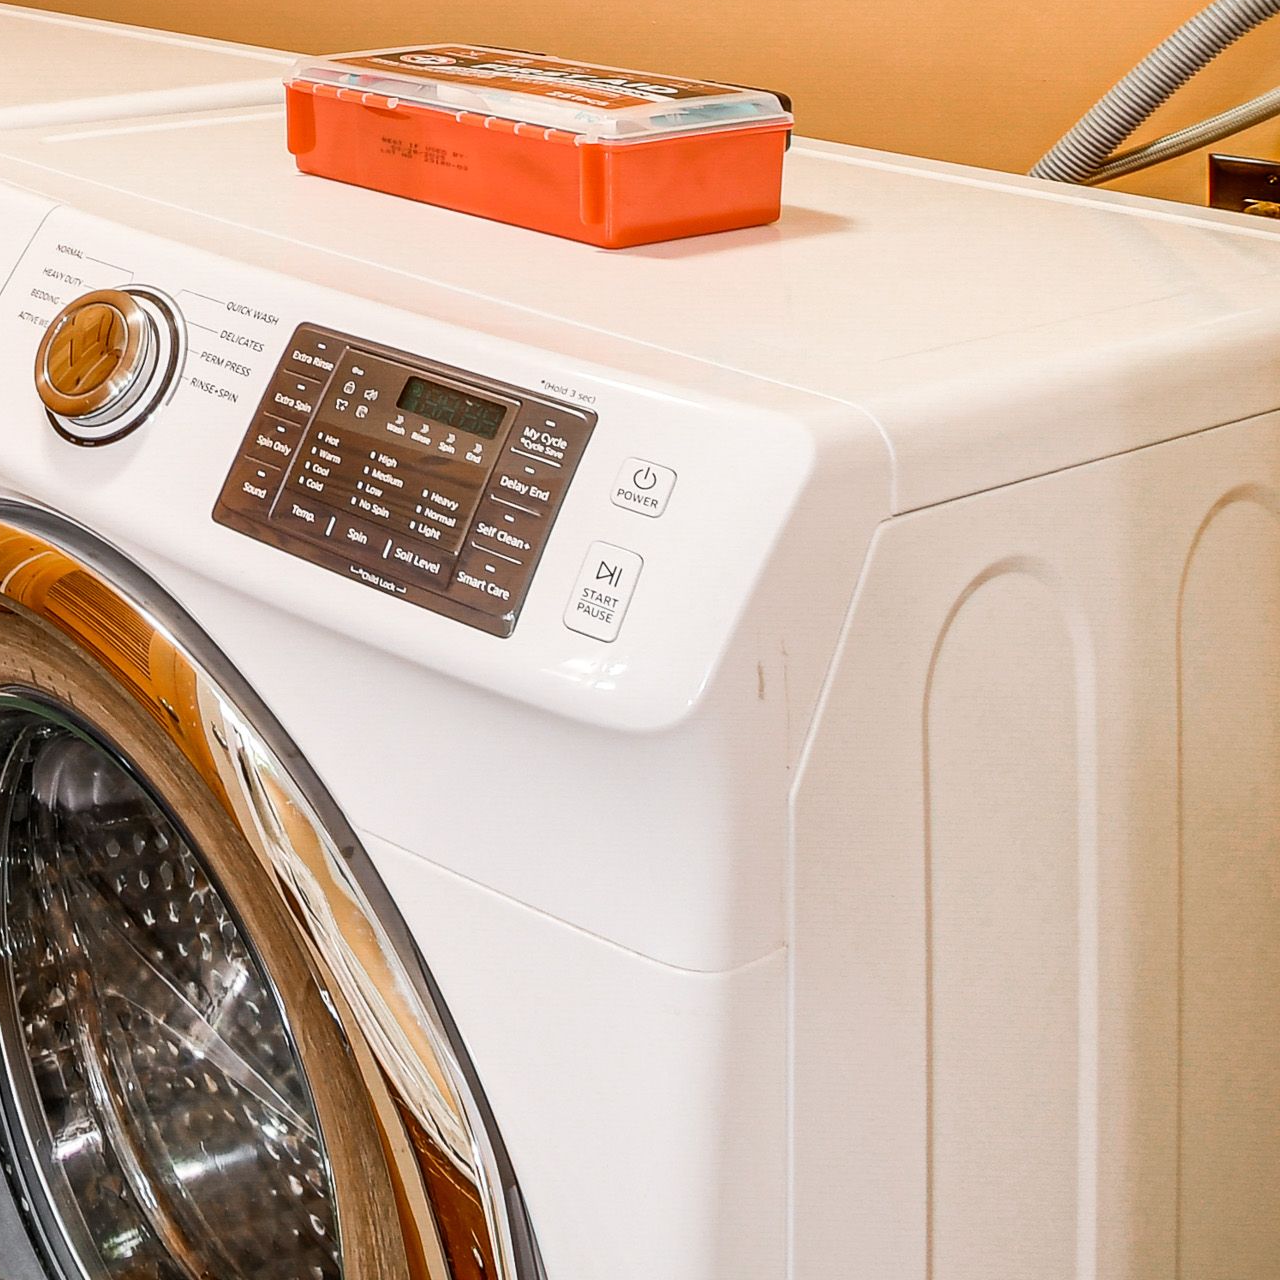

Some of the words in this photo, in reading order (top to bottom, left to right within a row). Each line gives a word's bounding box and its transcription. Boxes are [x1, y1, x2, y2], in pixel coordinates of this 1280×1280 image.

[470, 63, 596, 80] FIRST
[586, 78, 679, 94] AID
[55, 244, 83, 259] NORMAL
[43, 267, 64, 281] HEAVY
[64, 274, 83, 287] DUTY
[30, 288, 60, 305] BEDDING
[226, 301, 253, 317] QUICK
[254, 309, 279, 326] WASH
[220, 330, 265, 353] DELICATES
[200, 351, 224, 366] PERM
[224, 360, 251, 377] PRESS
[292, 350, 313, 364] Extra
[313, 356, 334, 372] Rinse
[274, 392, 295, 407] Extra
[294, 399, 312, 413] Spin
[569, 389, 576, 398] 3
[578, 393, 596, 404] sec)
[256, 434, 274, 448] Spin
[273, 441, 292, 456] Only
[324, 435, 340, 447] Hot
[386, 422, 406, 436] Wash
[438, 441, 456, 455] Spin
[465, 451, 482, 464] End
[523, 426, 540, 440] My
[541, 433, 568, 450] Cycle
[319, 449, 342, 464] Warm
[377, 453, 398, 468] High
[312, 463, 330, 477] Cool
[371, 468, 404, 488] Medium
[242, 481, 267, 499] Sound
[306, 478, 324, 492] Cold
[365, 483, 384, 498] Low
[499, 475, 529, 495] Delay
[529, 485, 551, 501] End
[430, 491, 459, 511] Heavy
[616, 487, 659, 509] POWER
[358, 498, 372, 511] No
[371, 504, 390, 519] Spin
[423, 507, 457, 528] Normal
[346, 528, 368, 545] Spin
[417, 522, 442, 541] Light
[476, 522, 498, 538] Self
[394, 547, 413, 563] Soil
[413, 554, 441, 575] Level
[379, 577, 396, 592] Lock
[456, 571, 487, 591] Smart
[487, 583, 510, 601] Care
[582, 587, 619, 609] START
[576, 602, 614, 624] PAUSE
